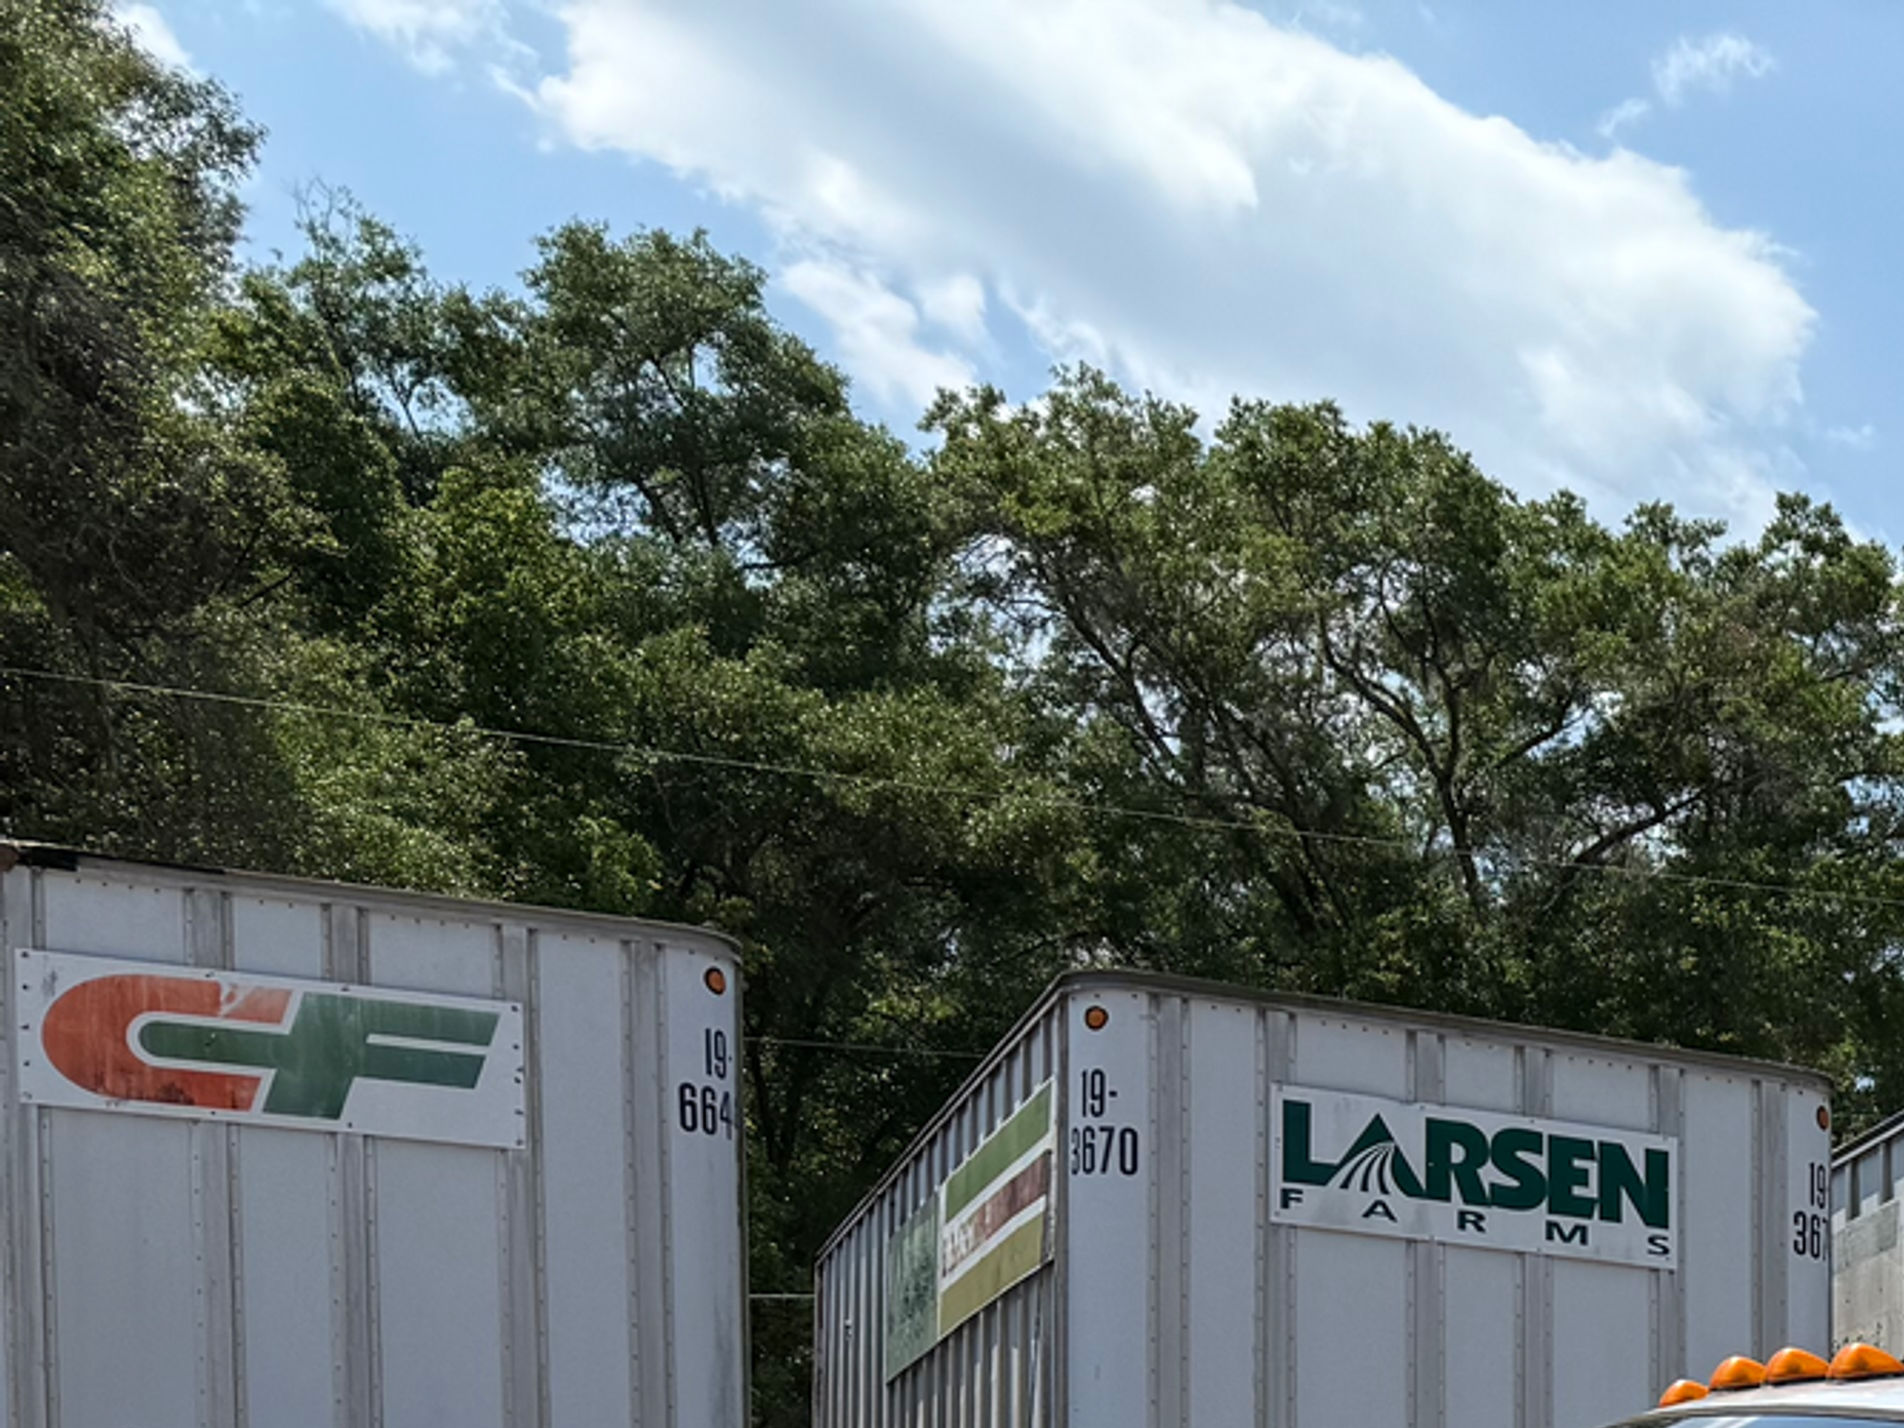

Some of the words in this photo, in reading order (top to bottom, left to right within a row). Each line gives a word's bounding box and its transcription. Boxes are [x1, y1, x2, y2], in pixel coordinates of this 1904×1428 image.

[678, 1082, 735, 1141] 664
[1081, 1068, 1118, 1118] 19-
[1071, 1126, 1138, 1176] 3670
[1282, 1100, 1669, 1229] LARSEN
[1281, 1188, 1670, 1256] FARMS
